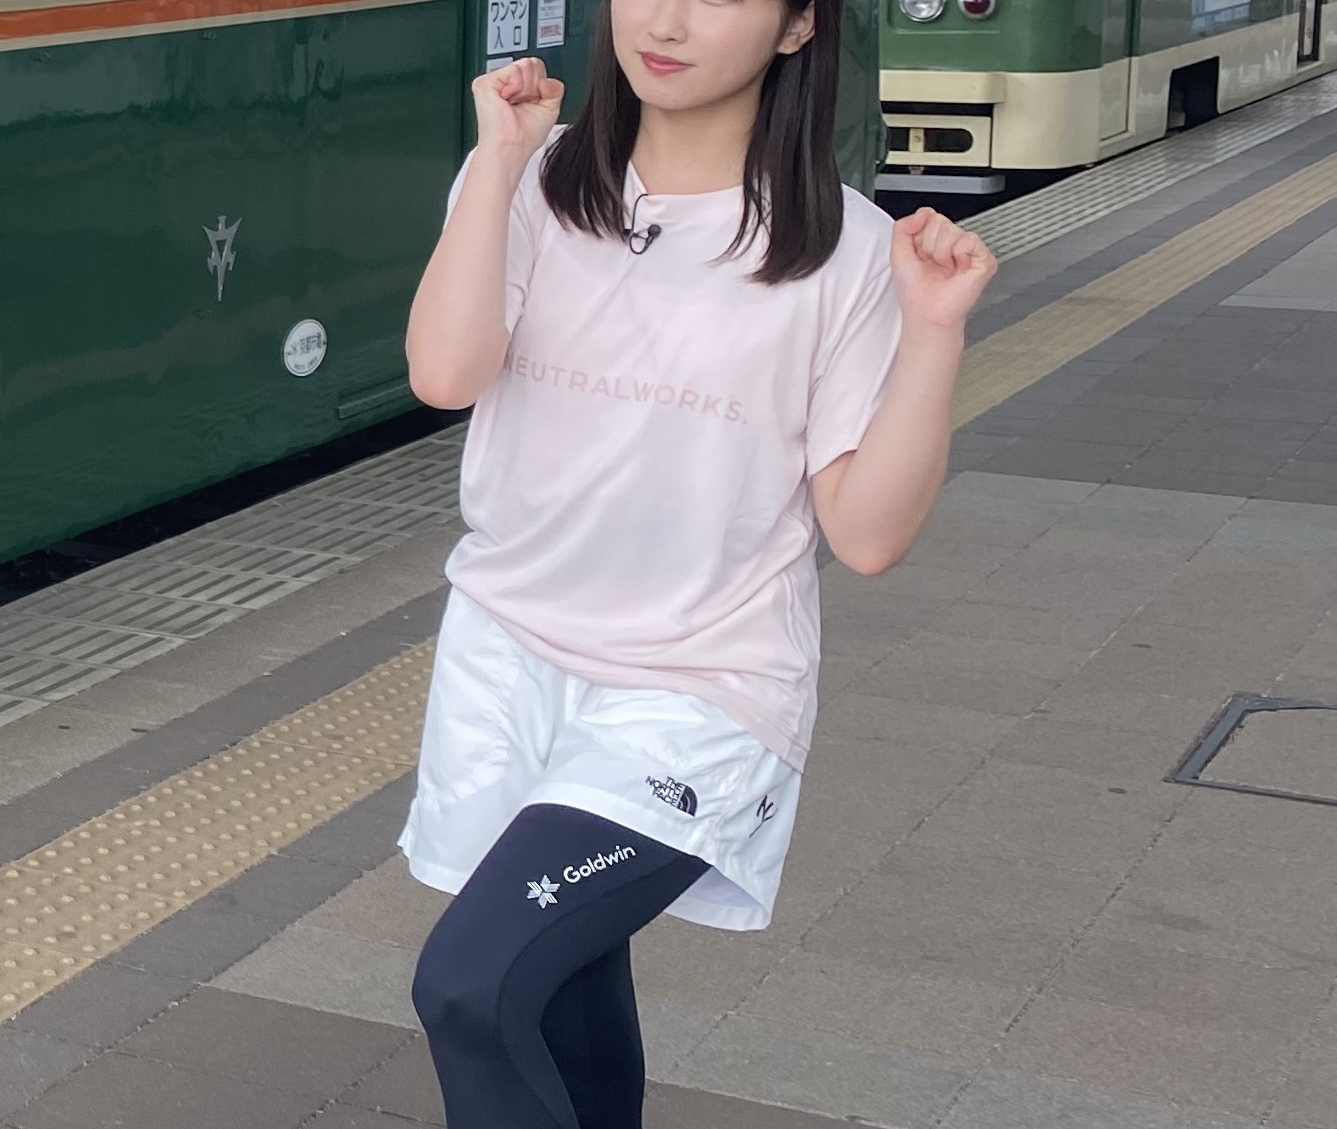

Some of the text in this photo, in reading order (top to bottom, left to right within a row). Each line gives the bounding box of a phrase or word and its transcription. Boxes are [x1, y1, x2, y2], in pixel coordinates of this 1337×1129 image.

[491, 0, 527, 22] ワンマン
[645, 776, 681, 802] NORTH
[666, 776, 683, 792] THE
[652, 786, 679, 809] FACE
[563, 845, 636, 884] Goldwin
